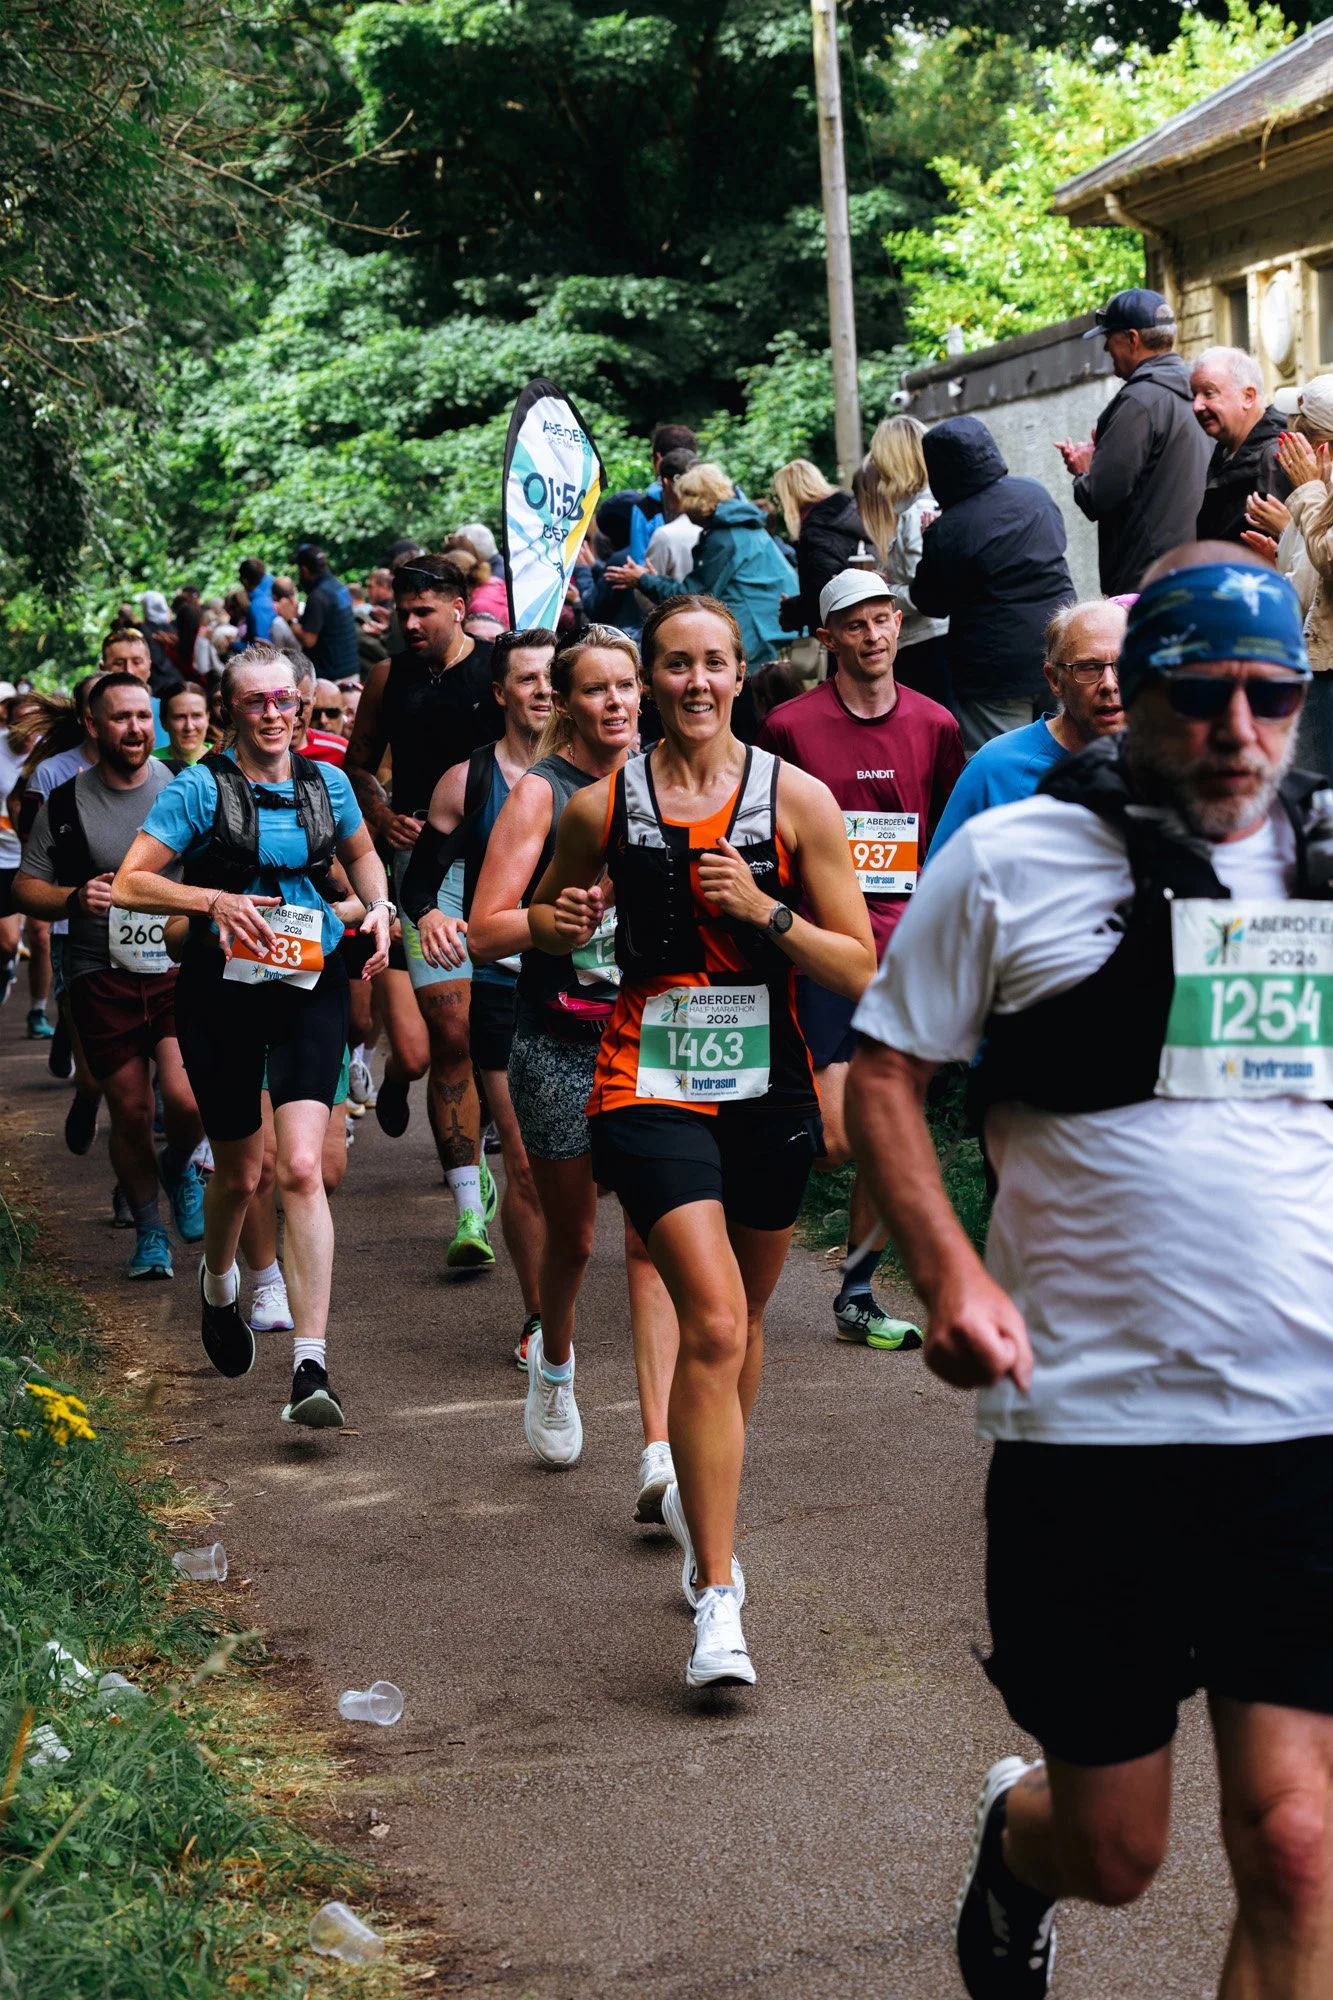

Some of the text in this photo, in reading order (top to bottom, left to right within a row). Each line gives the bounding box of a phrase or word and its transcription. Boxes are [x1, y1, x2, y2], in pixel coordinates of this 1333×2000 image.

[856, 769, 895, 779] BANDIT
[866, 818, 906, 826] ABERDEEN
[853, 842, 898, 869] 937
[865, 875, 895, 885] hydrasun
[274, 908, 313, 923] ABERDEEN
[284, 925, 302, 935] 2026
[1249, 916, 1333, 933] ABERDEE
[1269, 950, 1318, 966] 2026
[690, 994, 756, 1005] ABERDEEN
[689, 1005, 755, 1013] HALF MARATHON
[1211, 979, 1322, 1042] 1254
[706, 1014, 738, 1024] 2026
[667, 1031, 744, 1068] 1463
[691, 1077, 737, 1091] hydrasun
